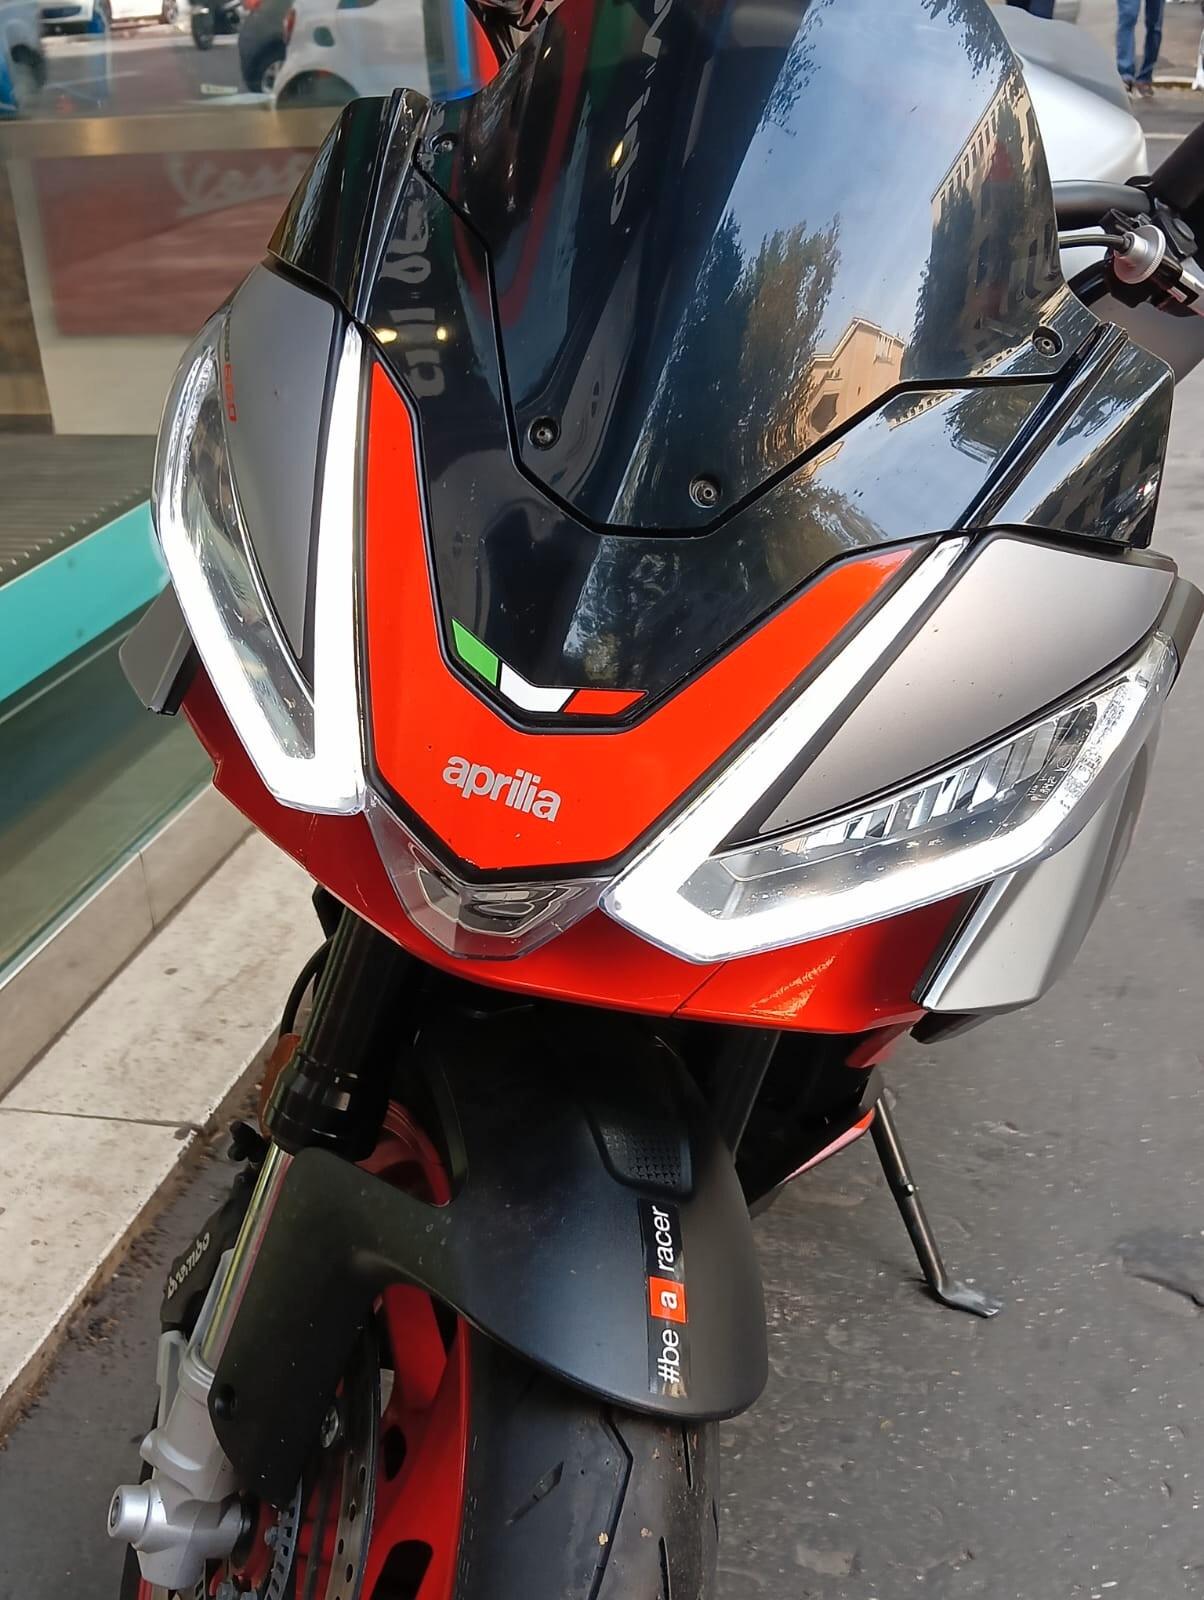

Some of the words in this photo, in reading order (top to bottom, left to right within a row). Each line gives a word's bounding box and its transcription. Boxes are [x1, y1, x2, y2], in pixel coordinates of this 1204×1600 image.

[442, 755, 562, 823] aprilia
[167, 1231, 210, 1300] brembo
[651, 1205, 675, 1272] racer
[660, 1290, 678, 1310] a
[657, 1329, 680, 1384] #be
